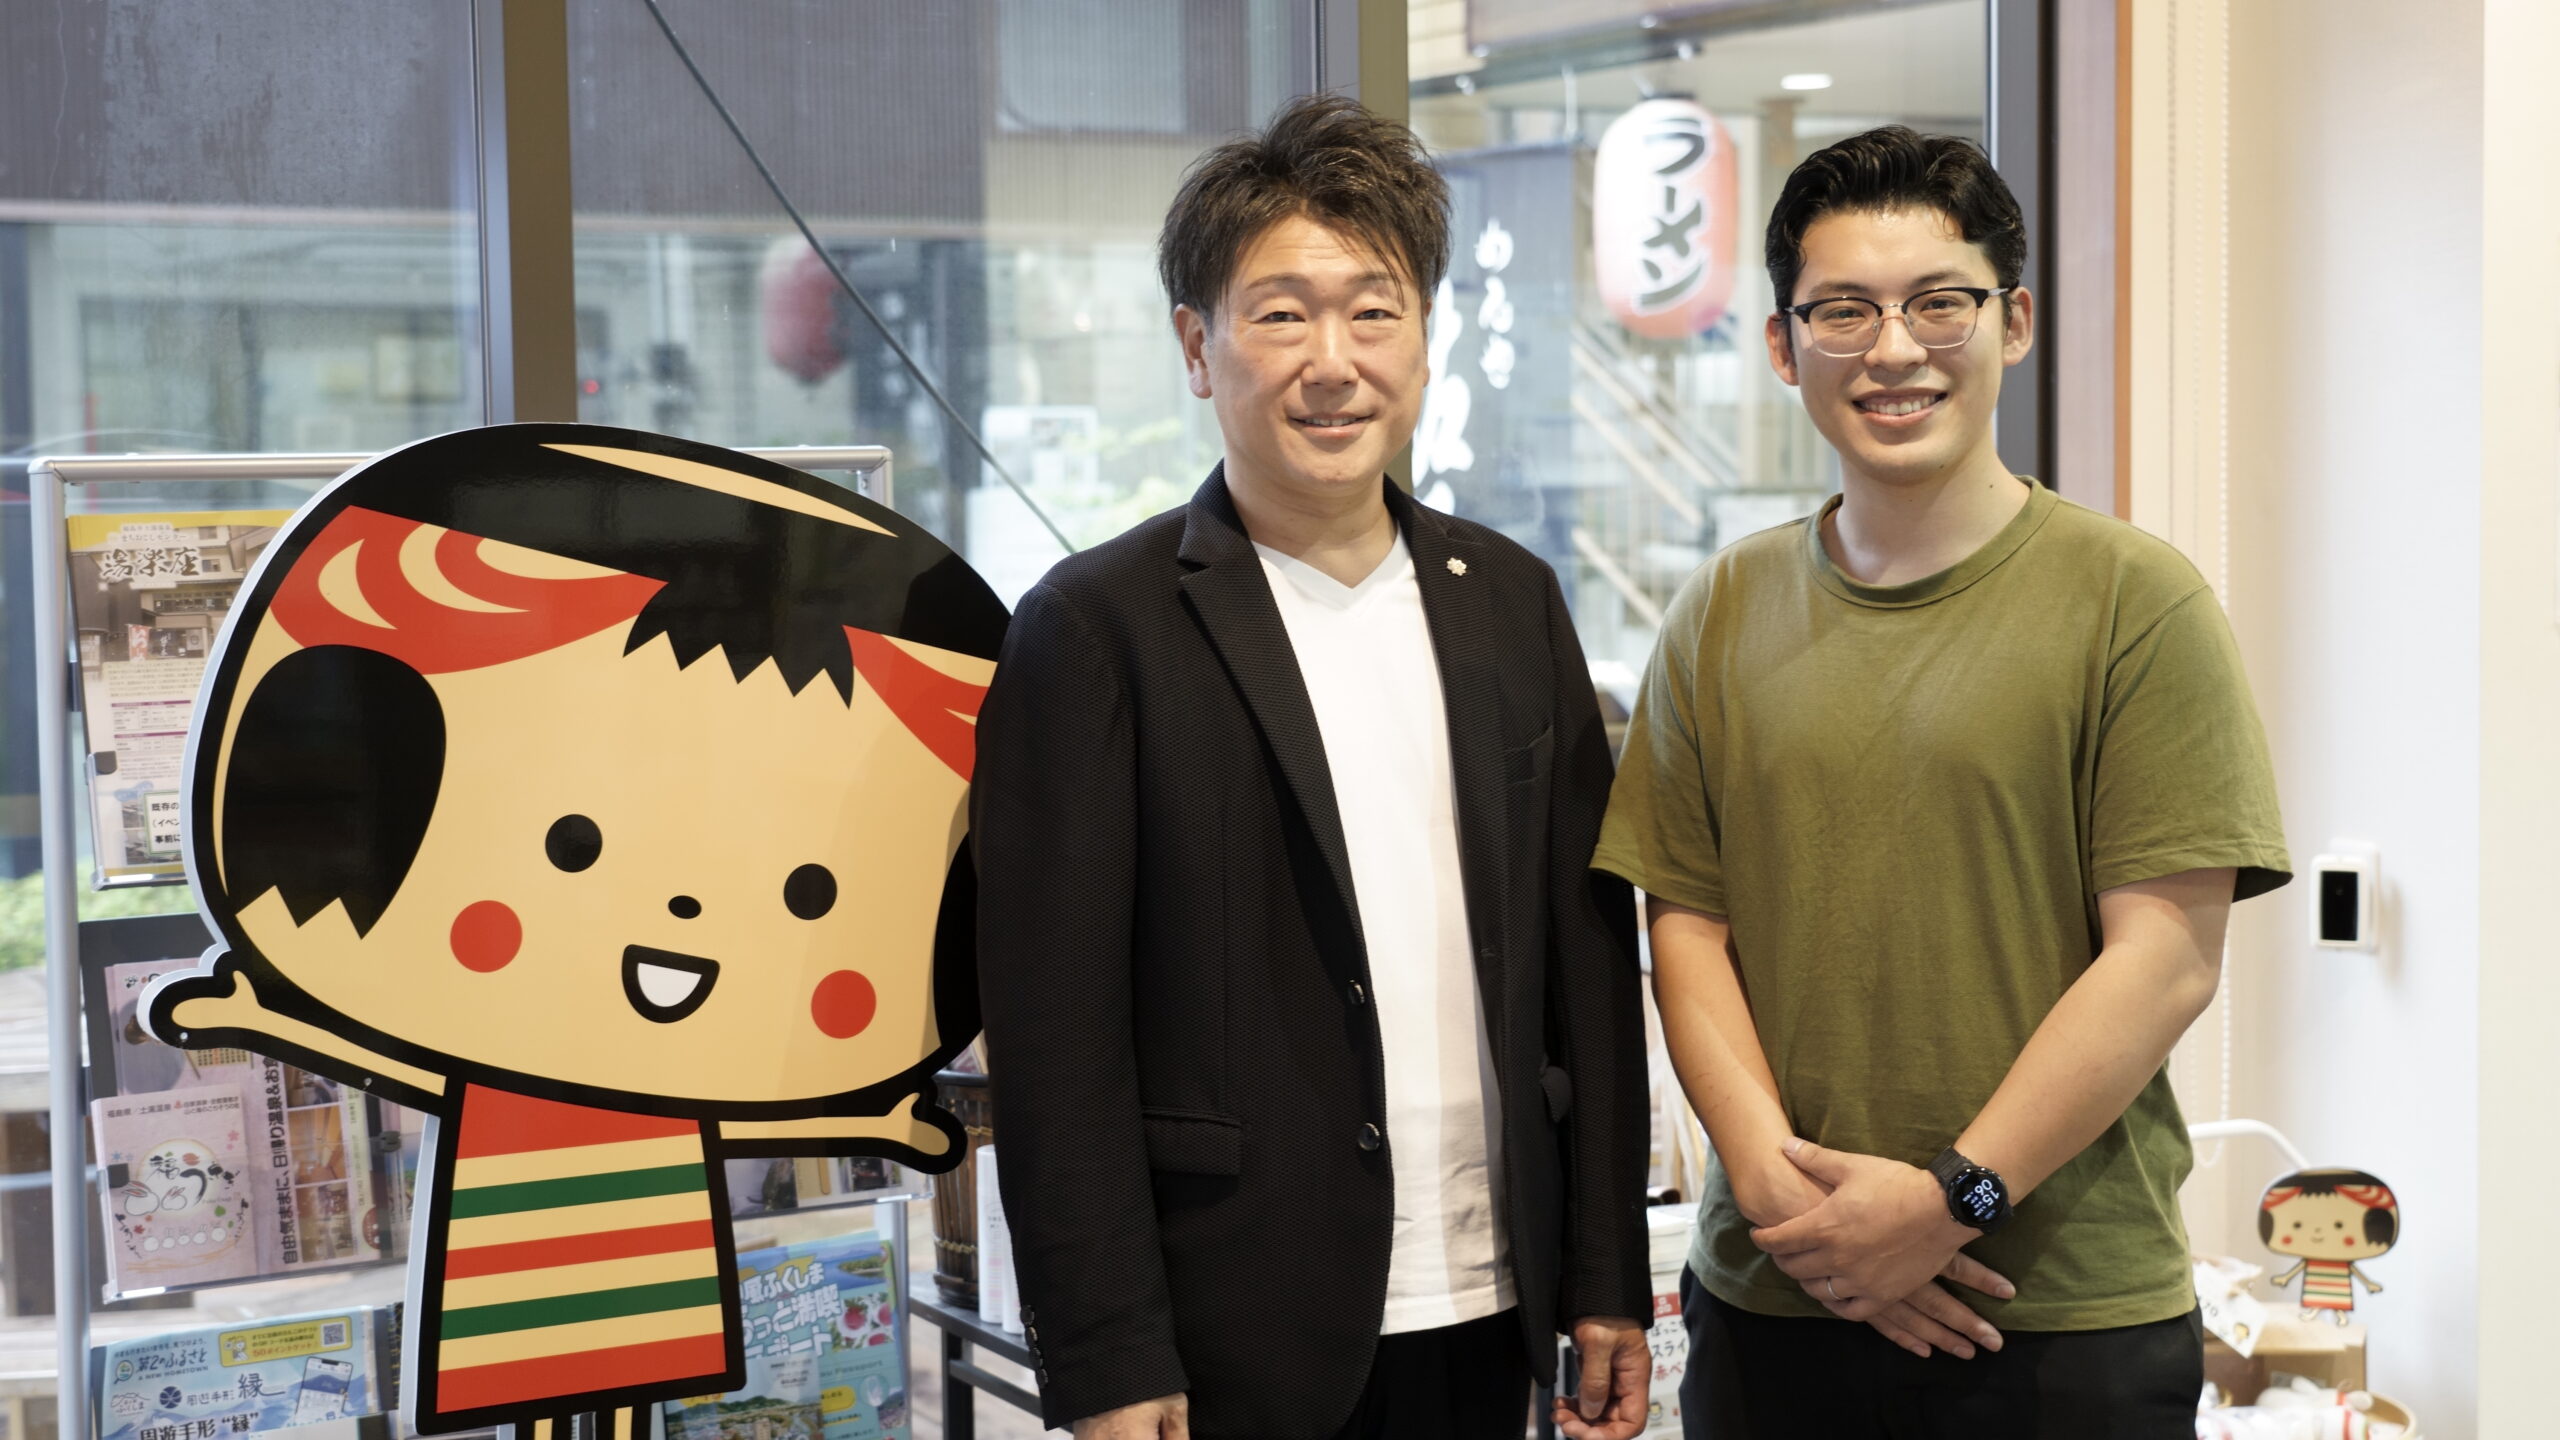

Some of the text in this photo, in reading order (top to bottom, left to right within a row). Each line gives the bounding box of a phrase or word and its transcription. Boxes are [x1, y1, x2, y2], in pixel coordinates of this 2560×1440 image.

[1637, 117, 1707, 311] ラーメン
[101, 546, 201, 578] 湯楽座
[1981, 1189, 2000, 1206] 15
[740, 1262, 825, 1304] 風ふくしま
